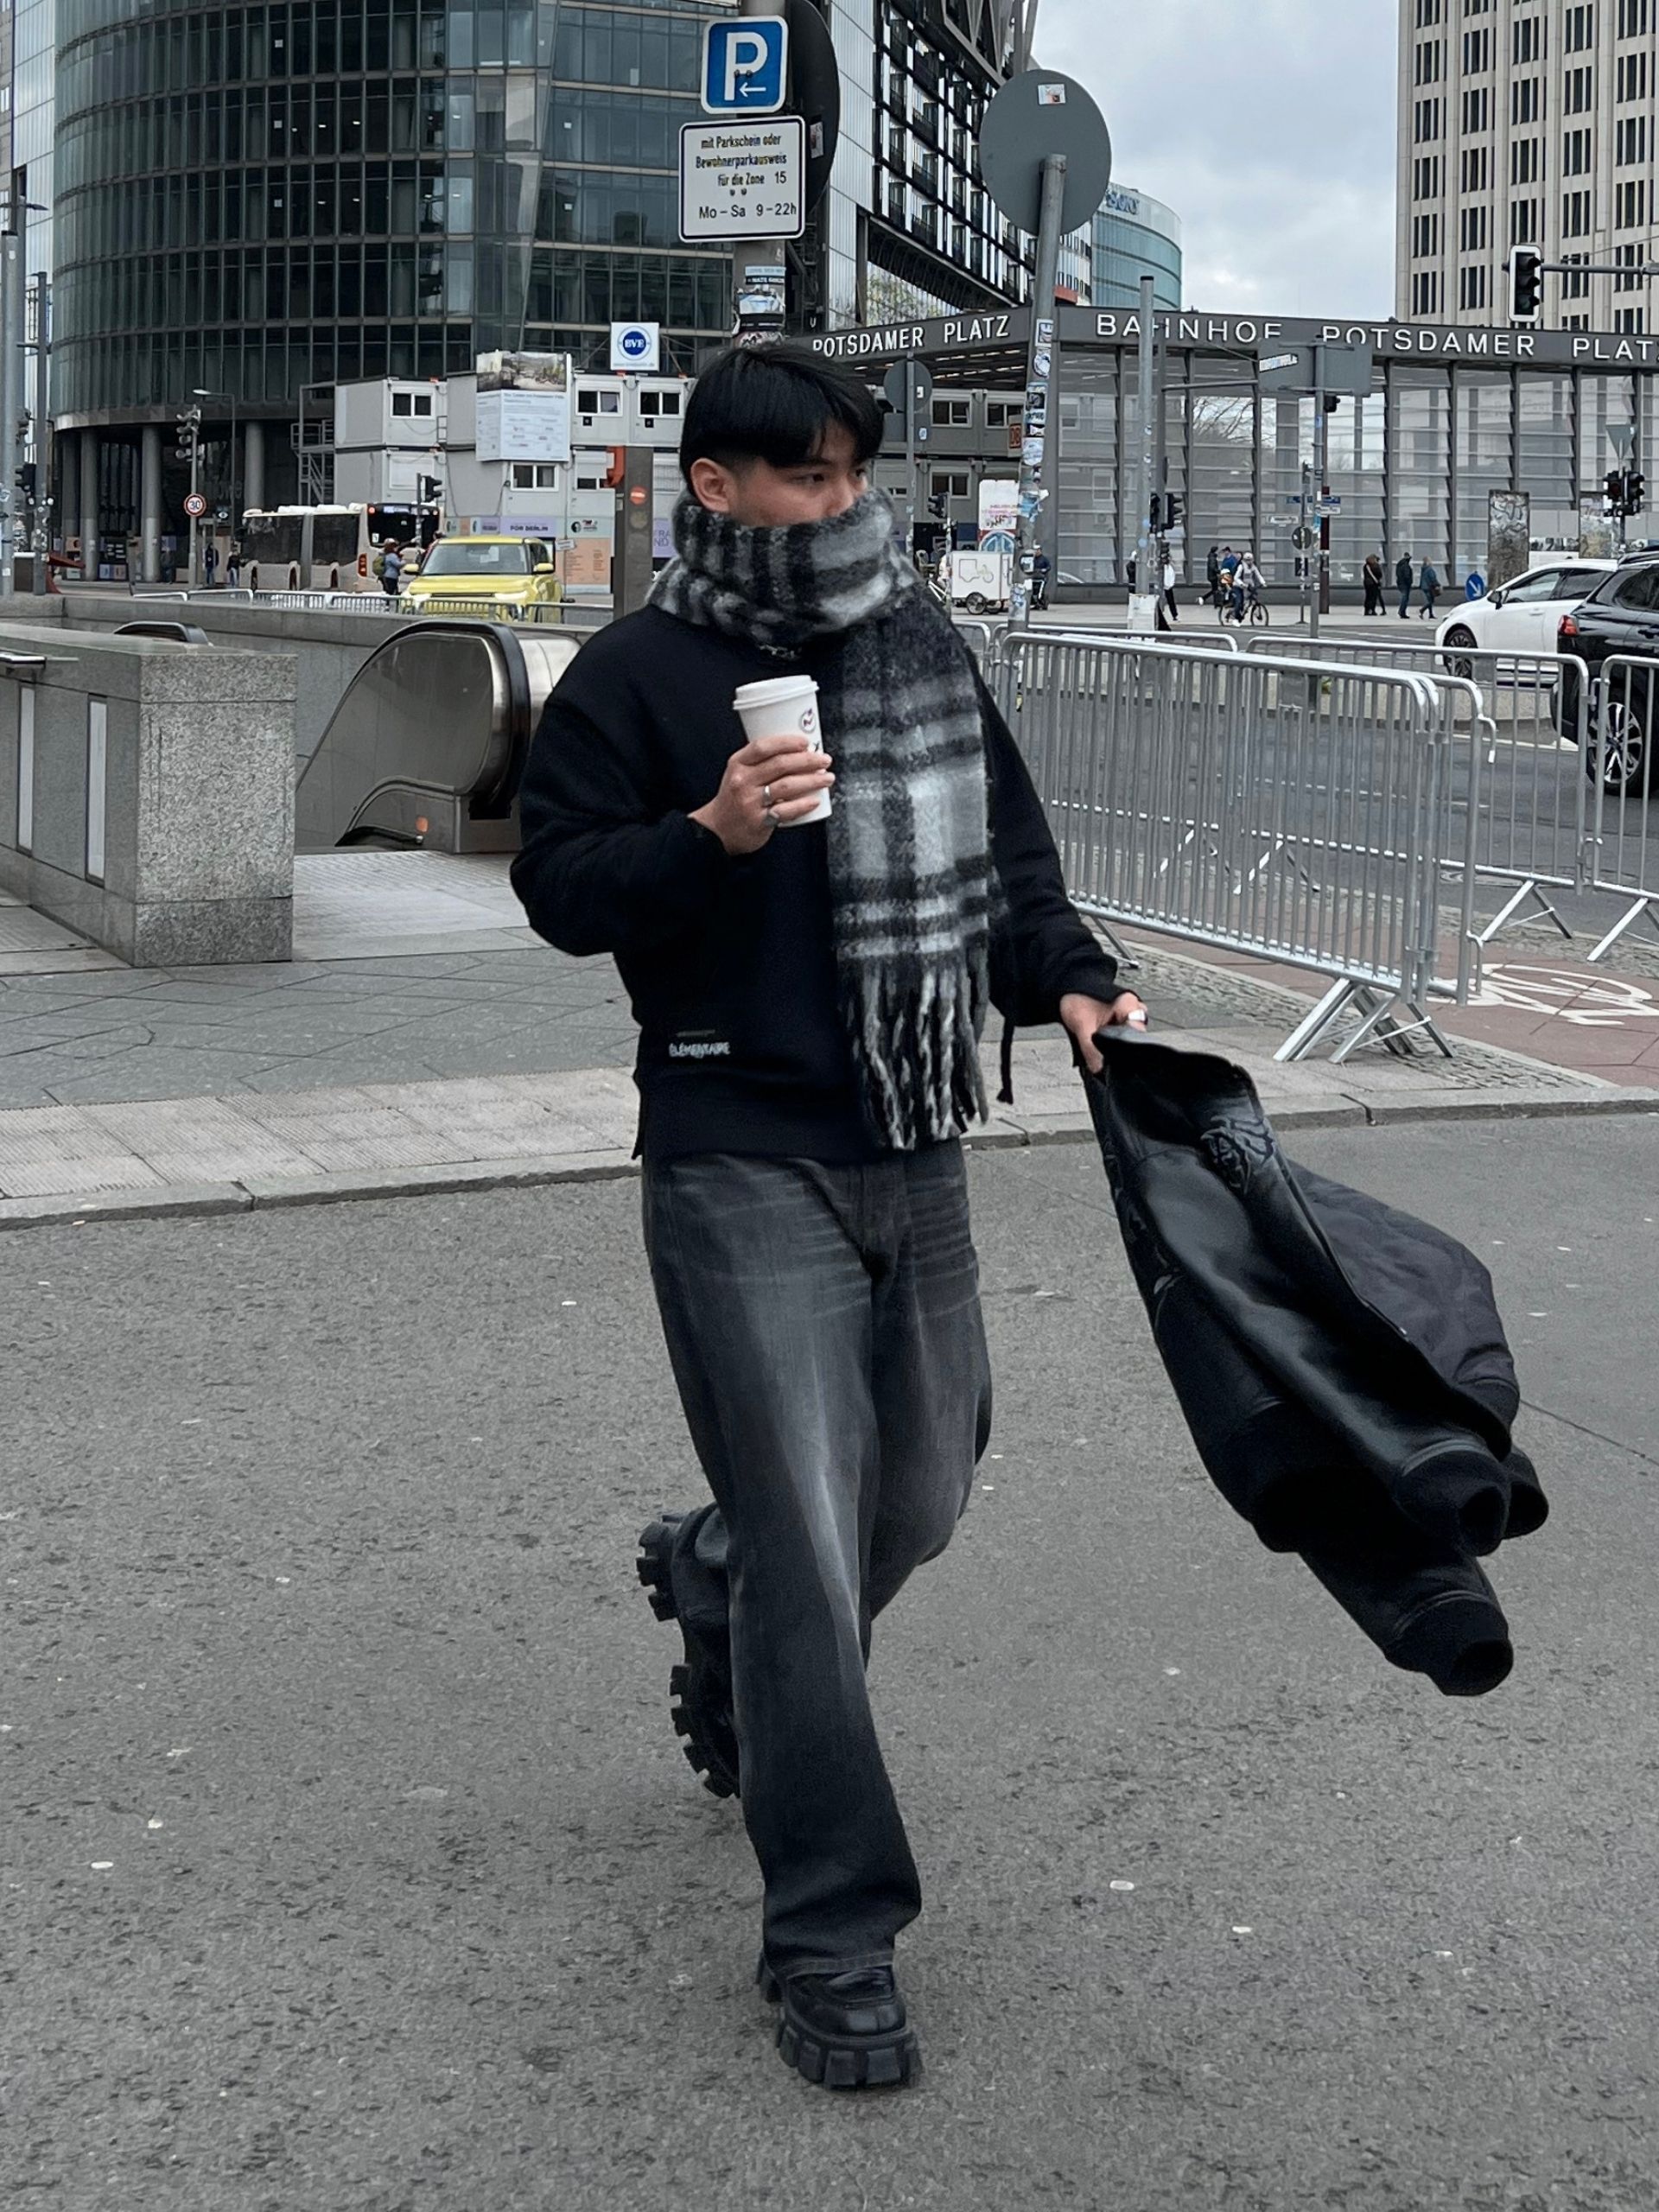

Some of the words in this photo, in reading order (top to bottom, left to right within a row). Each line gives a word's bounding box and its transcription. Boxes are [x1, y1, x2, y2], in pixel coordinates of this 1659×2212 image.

[724, 32, 768, 101] P
[701, 137, 715, 149] mit
[716, 134, 761, 149] Parkschein
[763, 133, 781, 146] oder
[696, 153, 787, 169] Bewohnerparkausweis
[731, 174, 743, 186] die
[746, 173, 765, 185] Zone
[774, 171, 787, 184] 15
[813, 326, 925, 358] POTSDAMER
[944, 315, 1009, 344] PLATZ
[1096, 314, 1282, 343] BAHNHOF
[1322, 326, 1534, 356] POTSDAMER
[1573, 337, 1659, 361] PLAT
[189, 500, 201, 510] 30
